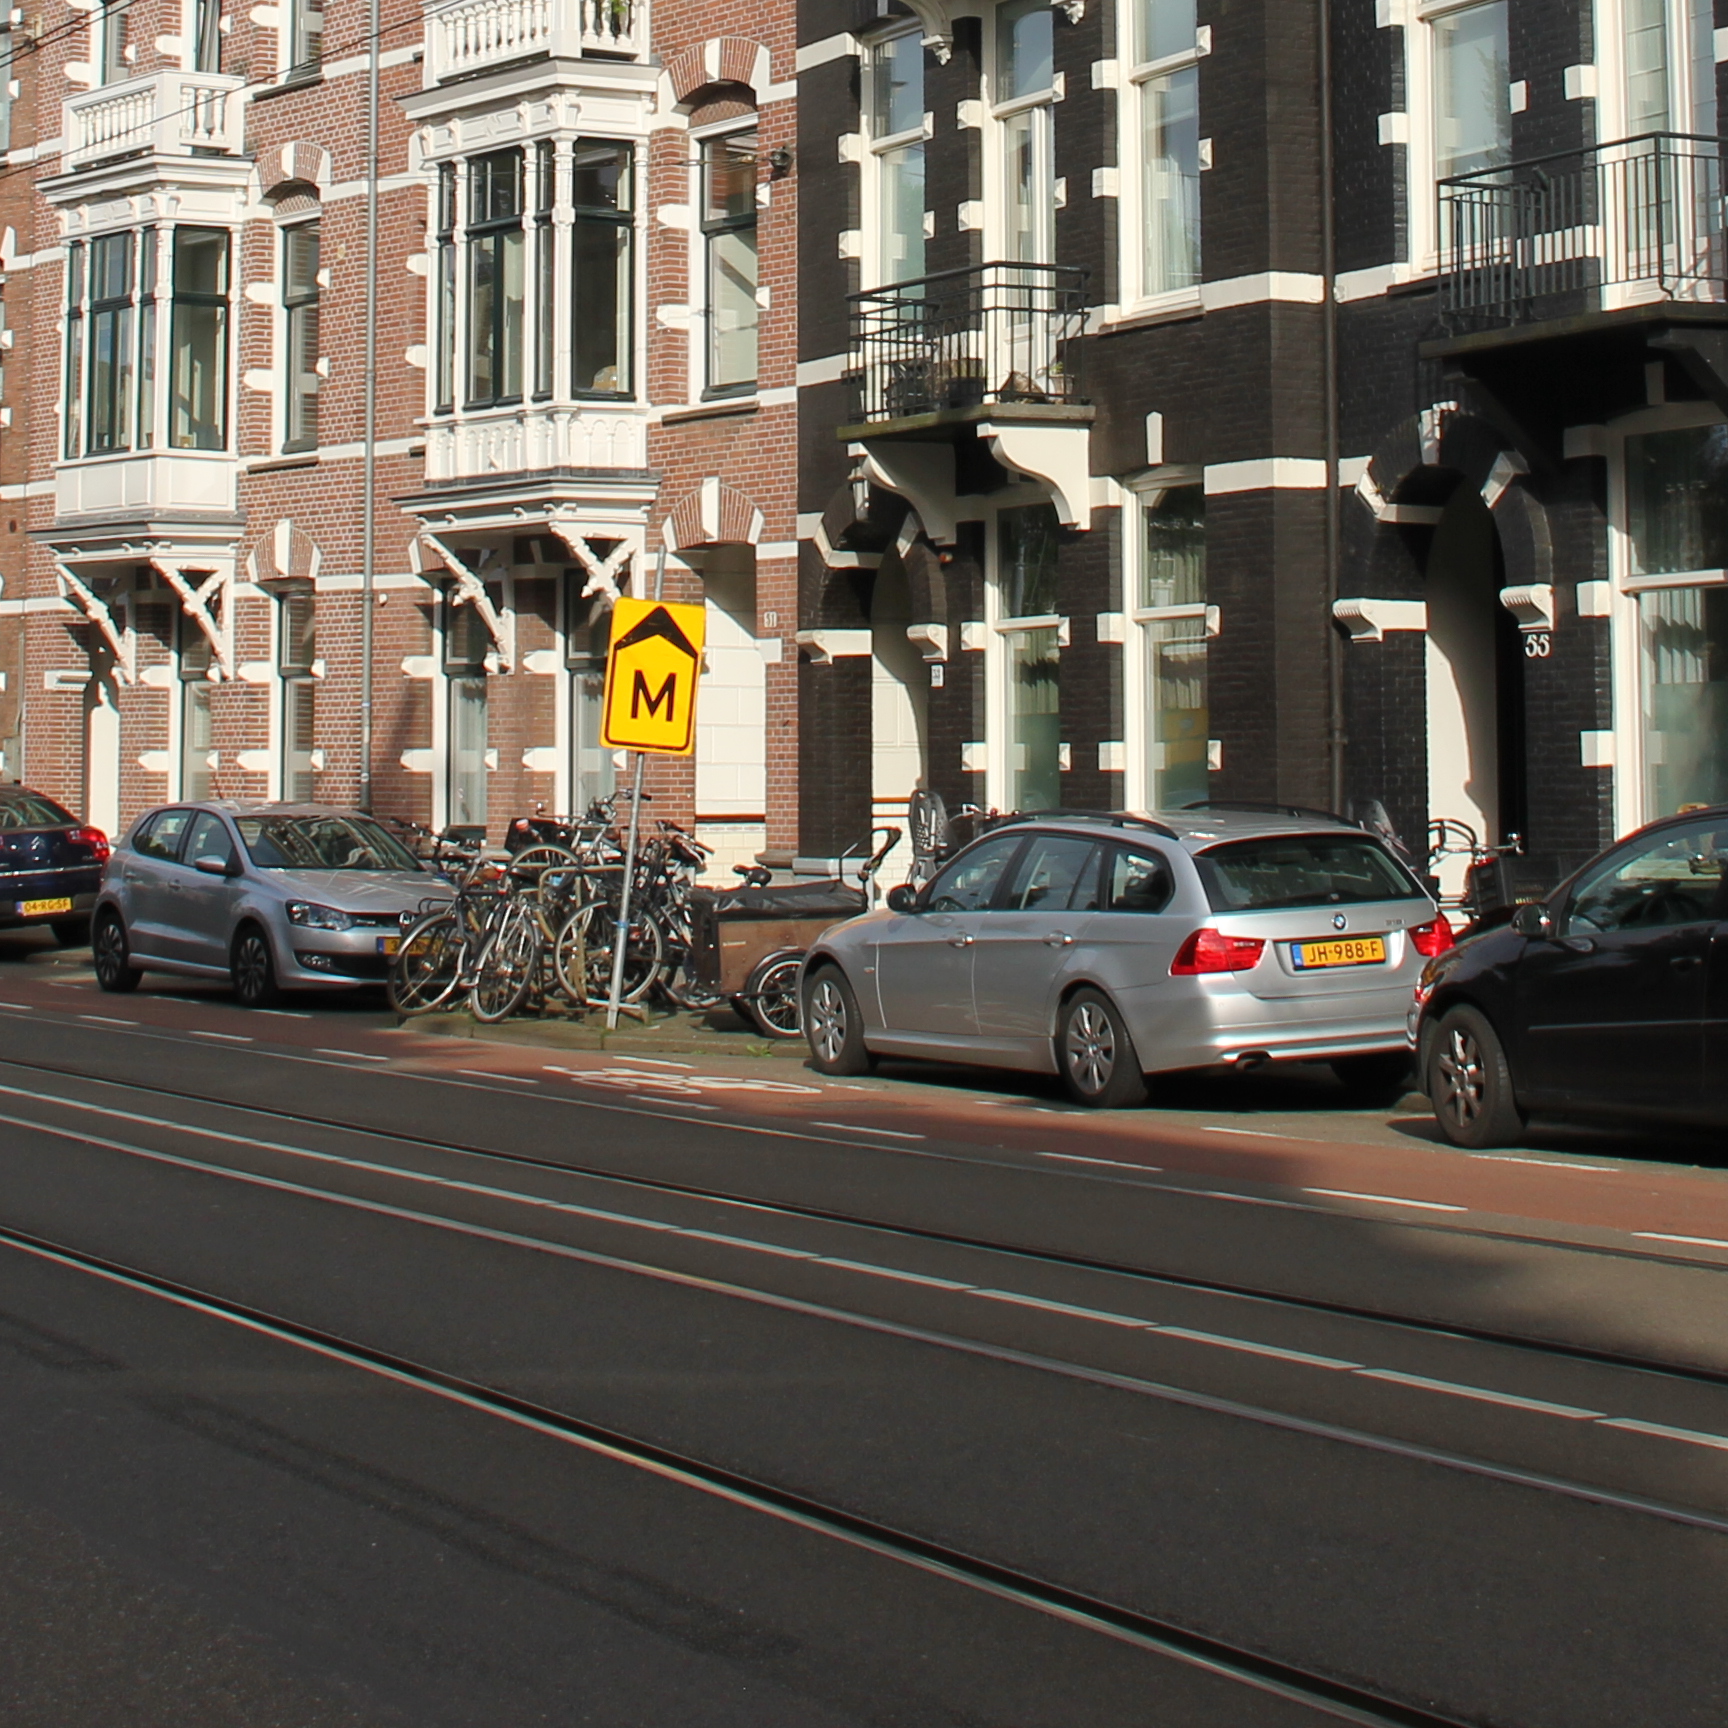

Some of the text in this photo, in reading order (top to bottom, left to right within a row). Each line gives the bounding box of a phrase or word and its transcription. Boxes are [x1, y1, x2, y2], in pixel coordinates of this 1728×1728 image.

[1524, 633, 1551, 658] 55
[630, 669, 677, 722] M
[1308, 941, 1379, 964] JH-988-F
